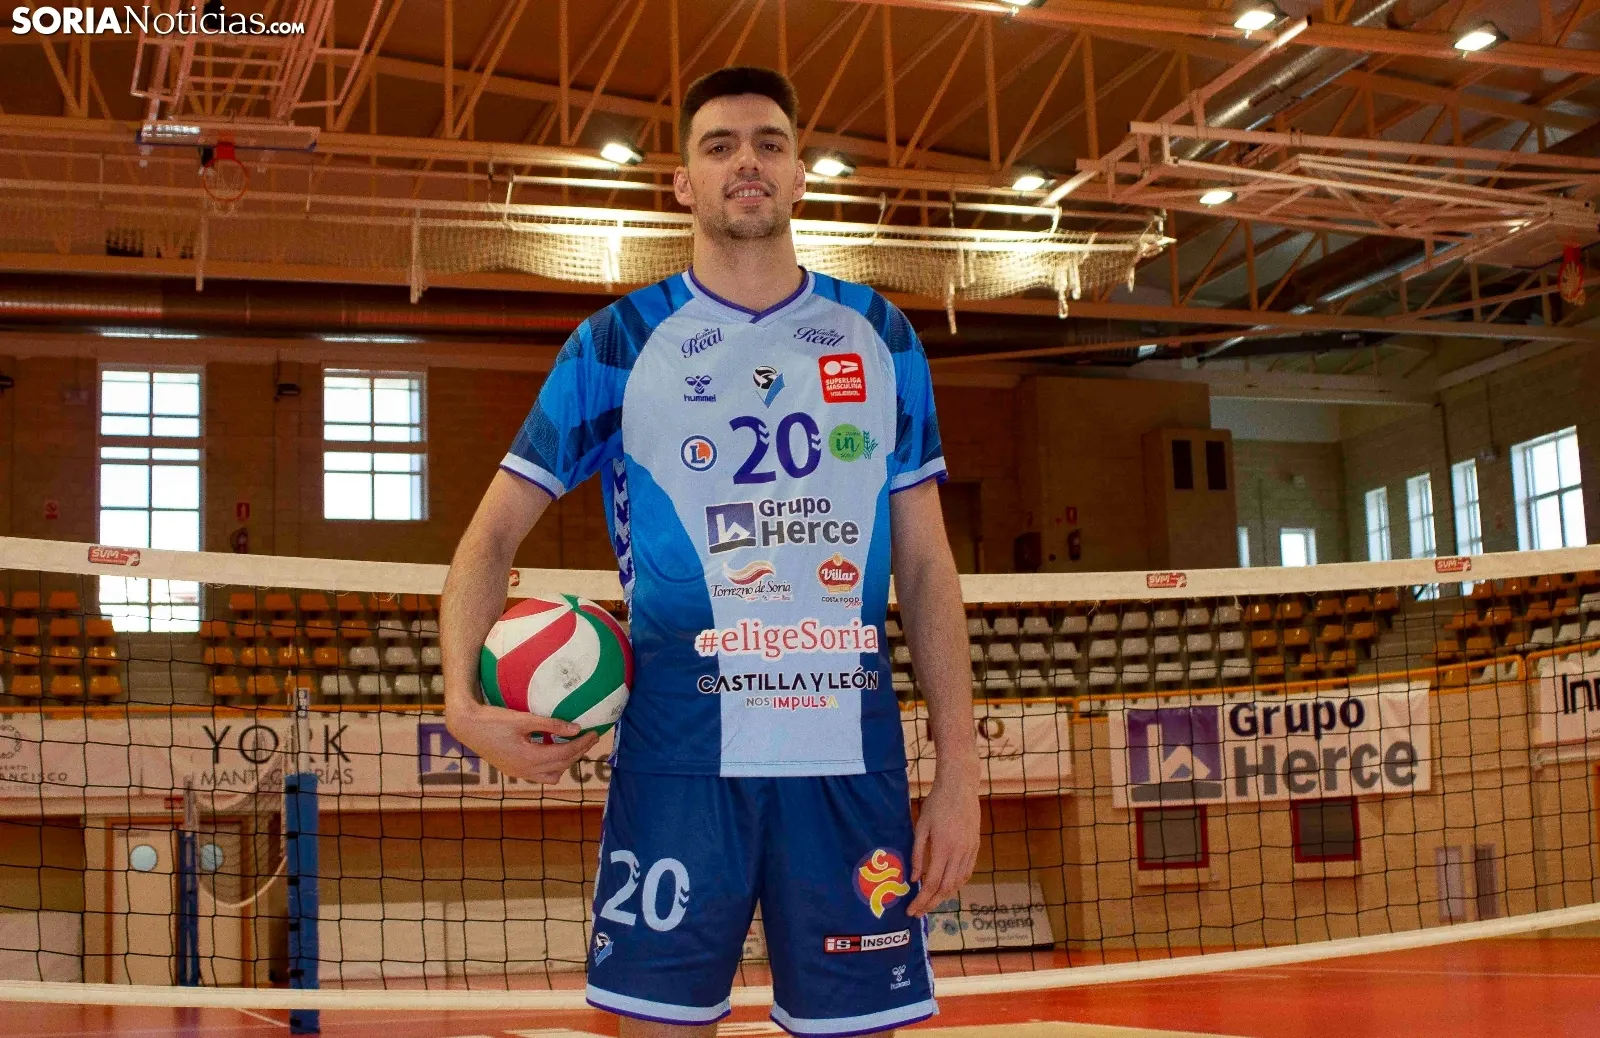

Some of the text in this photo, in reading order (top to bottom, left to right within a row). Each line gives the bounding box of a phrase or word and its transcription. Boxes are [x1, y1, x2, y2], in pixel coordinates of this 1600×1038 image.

[681, 327, 724, 358] Real
[793, 326, 845, 347] Real
[683, 394, 717, 402] hummel
[729, 411, 822, 484] 20
[758, 497, 831, 519] Grupo
[761, 520, 859, 546] Herce
[821, 568, 856, 581] Villar
[711, 584, 754, 598] Torrezno
[754, 581, 766, 594] de
[766, 580, 791, 593] Soria
[698, 620, 879, 658] #eligeSoria
[699, 666, 879, 693] CASTILLA Y LEÓN
[746, 695, 839, 711] NOS IMPULSA
[1229, 697, 1366, 741] Grupo
[1233, 741, 1419, 797] Herce
[600, 849, 690, 932] 20
[972, 918, 1034, 933] Oxgeno
[863, 933, 908, 948] INSOCA
